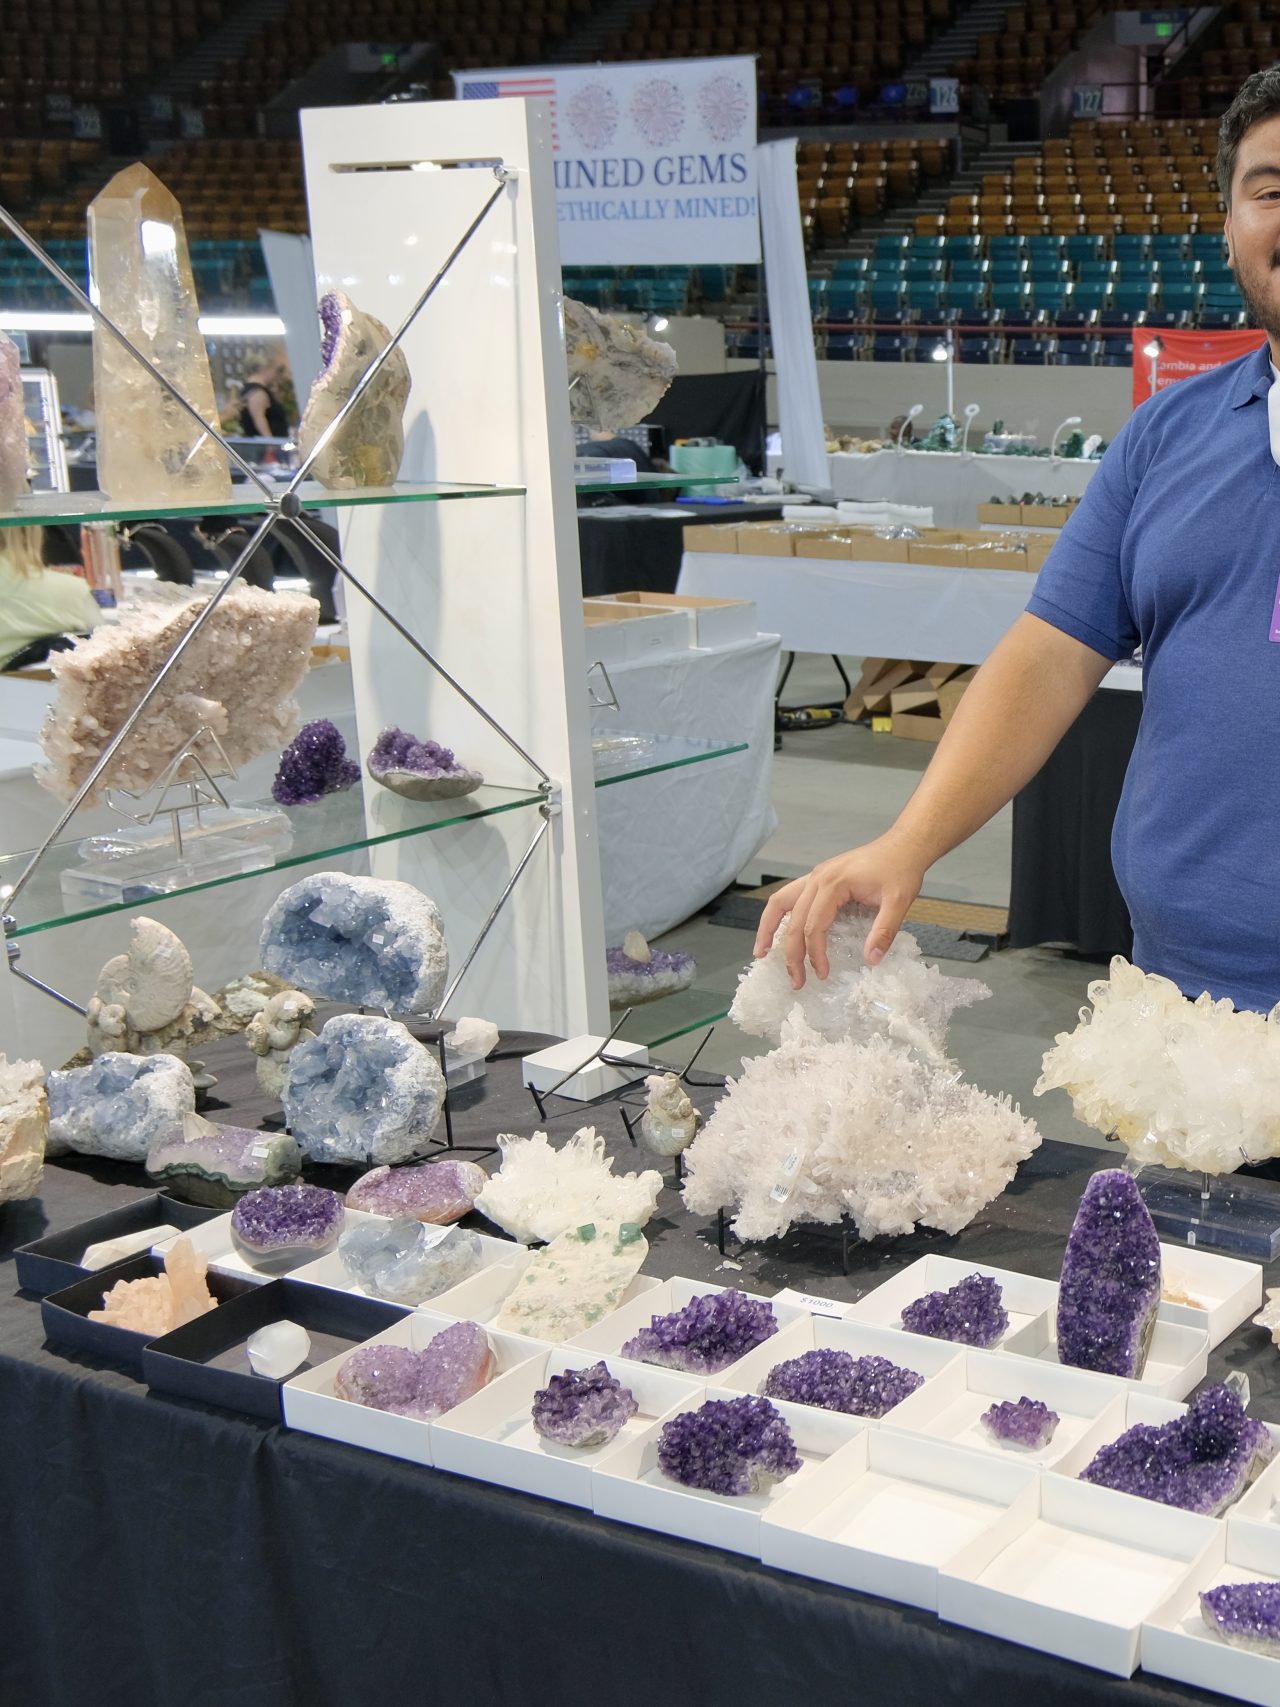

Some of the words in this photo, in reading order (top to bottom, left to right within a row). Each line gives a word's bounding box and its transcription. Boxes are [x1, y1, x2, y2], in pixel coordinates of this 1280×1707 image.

[936, 86, 959, 107] 126
[1079, 90, 1101, 112] 127
[653, 152, 748, 186] GEMS
[557, 198, 671, 222] ETHICALLY
[674, 196, 756, 219] MINED!
[1156, 361, 1196, 371] ambia
